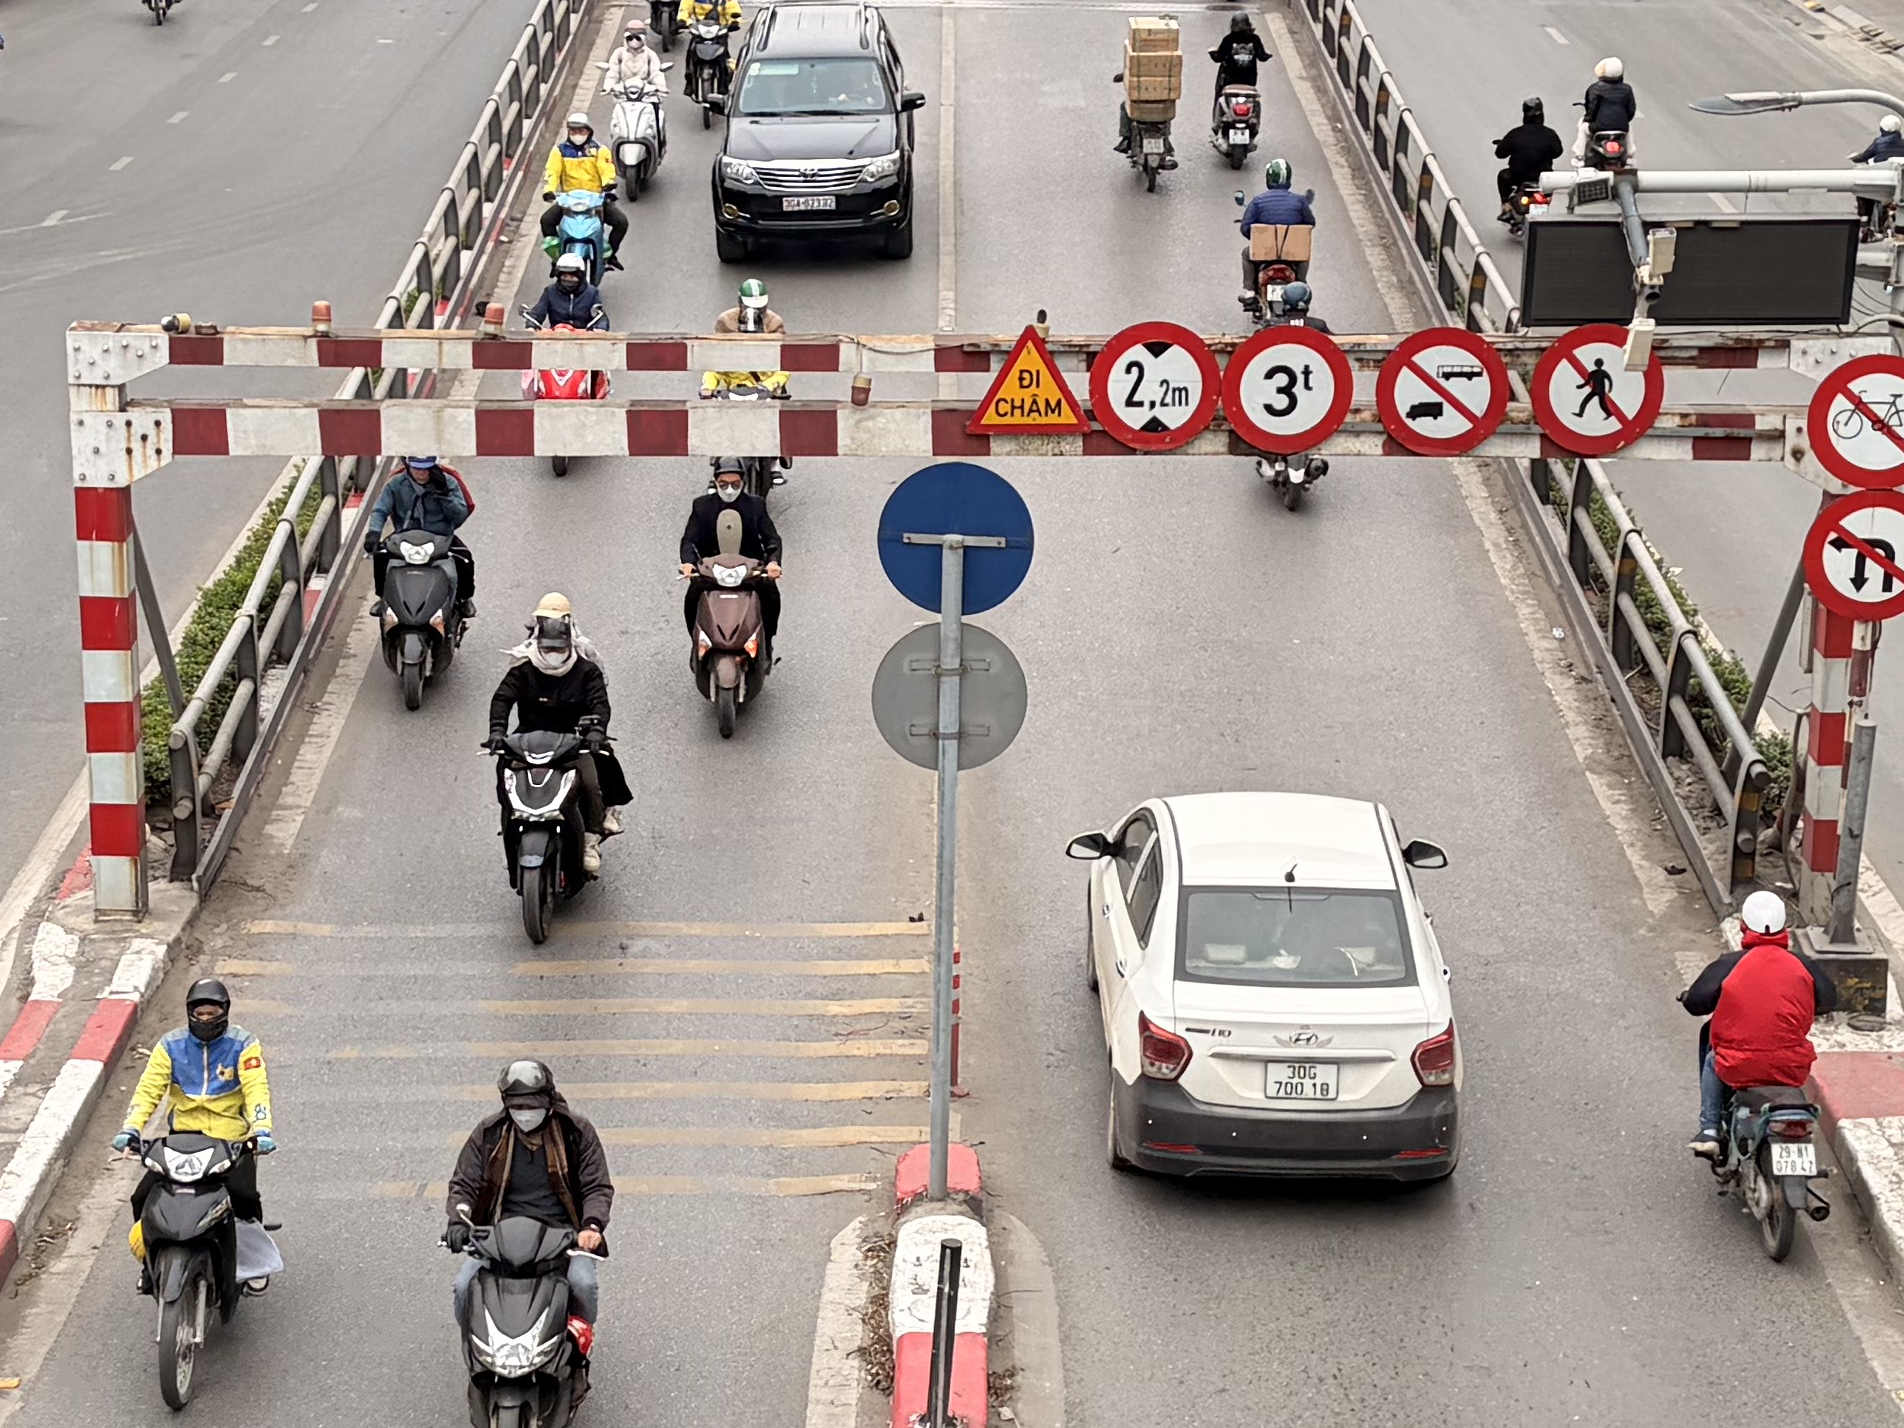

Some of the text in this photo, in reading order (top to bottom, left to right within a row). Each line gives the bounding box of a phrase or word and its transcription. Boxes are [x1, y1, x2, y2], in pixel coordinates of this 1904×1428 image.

[1018, 369, 1041, 389] ĐI
[1124, 360, 1189, 411] 2,2m
[1287, 1065, 1317, 1080] 30G
